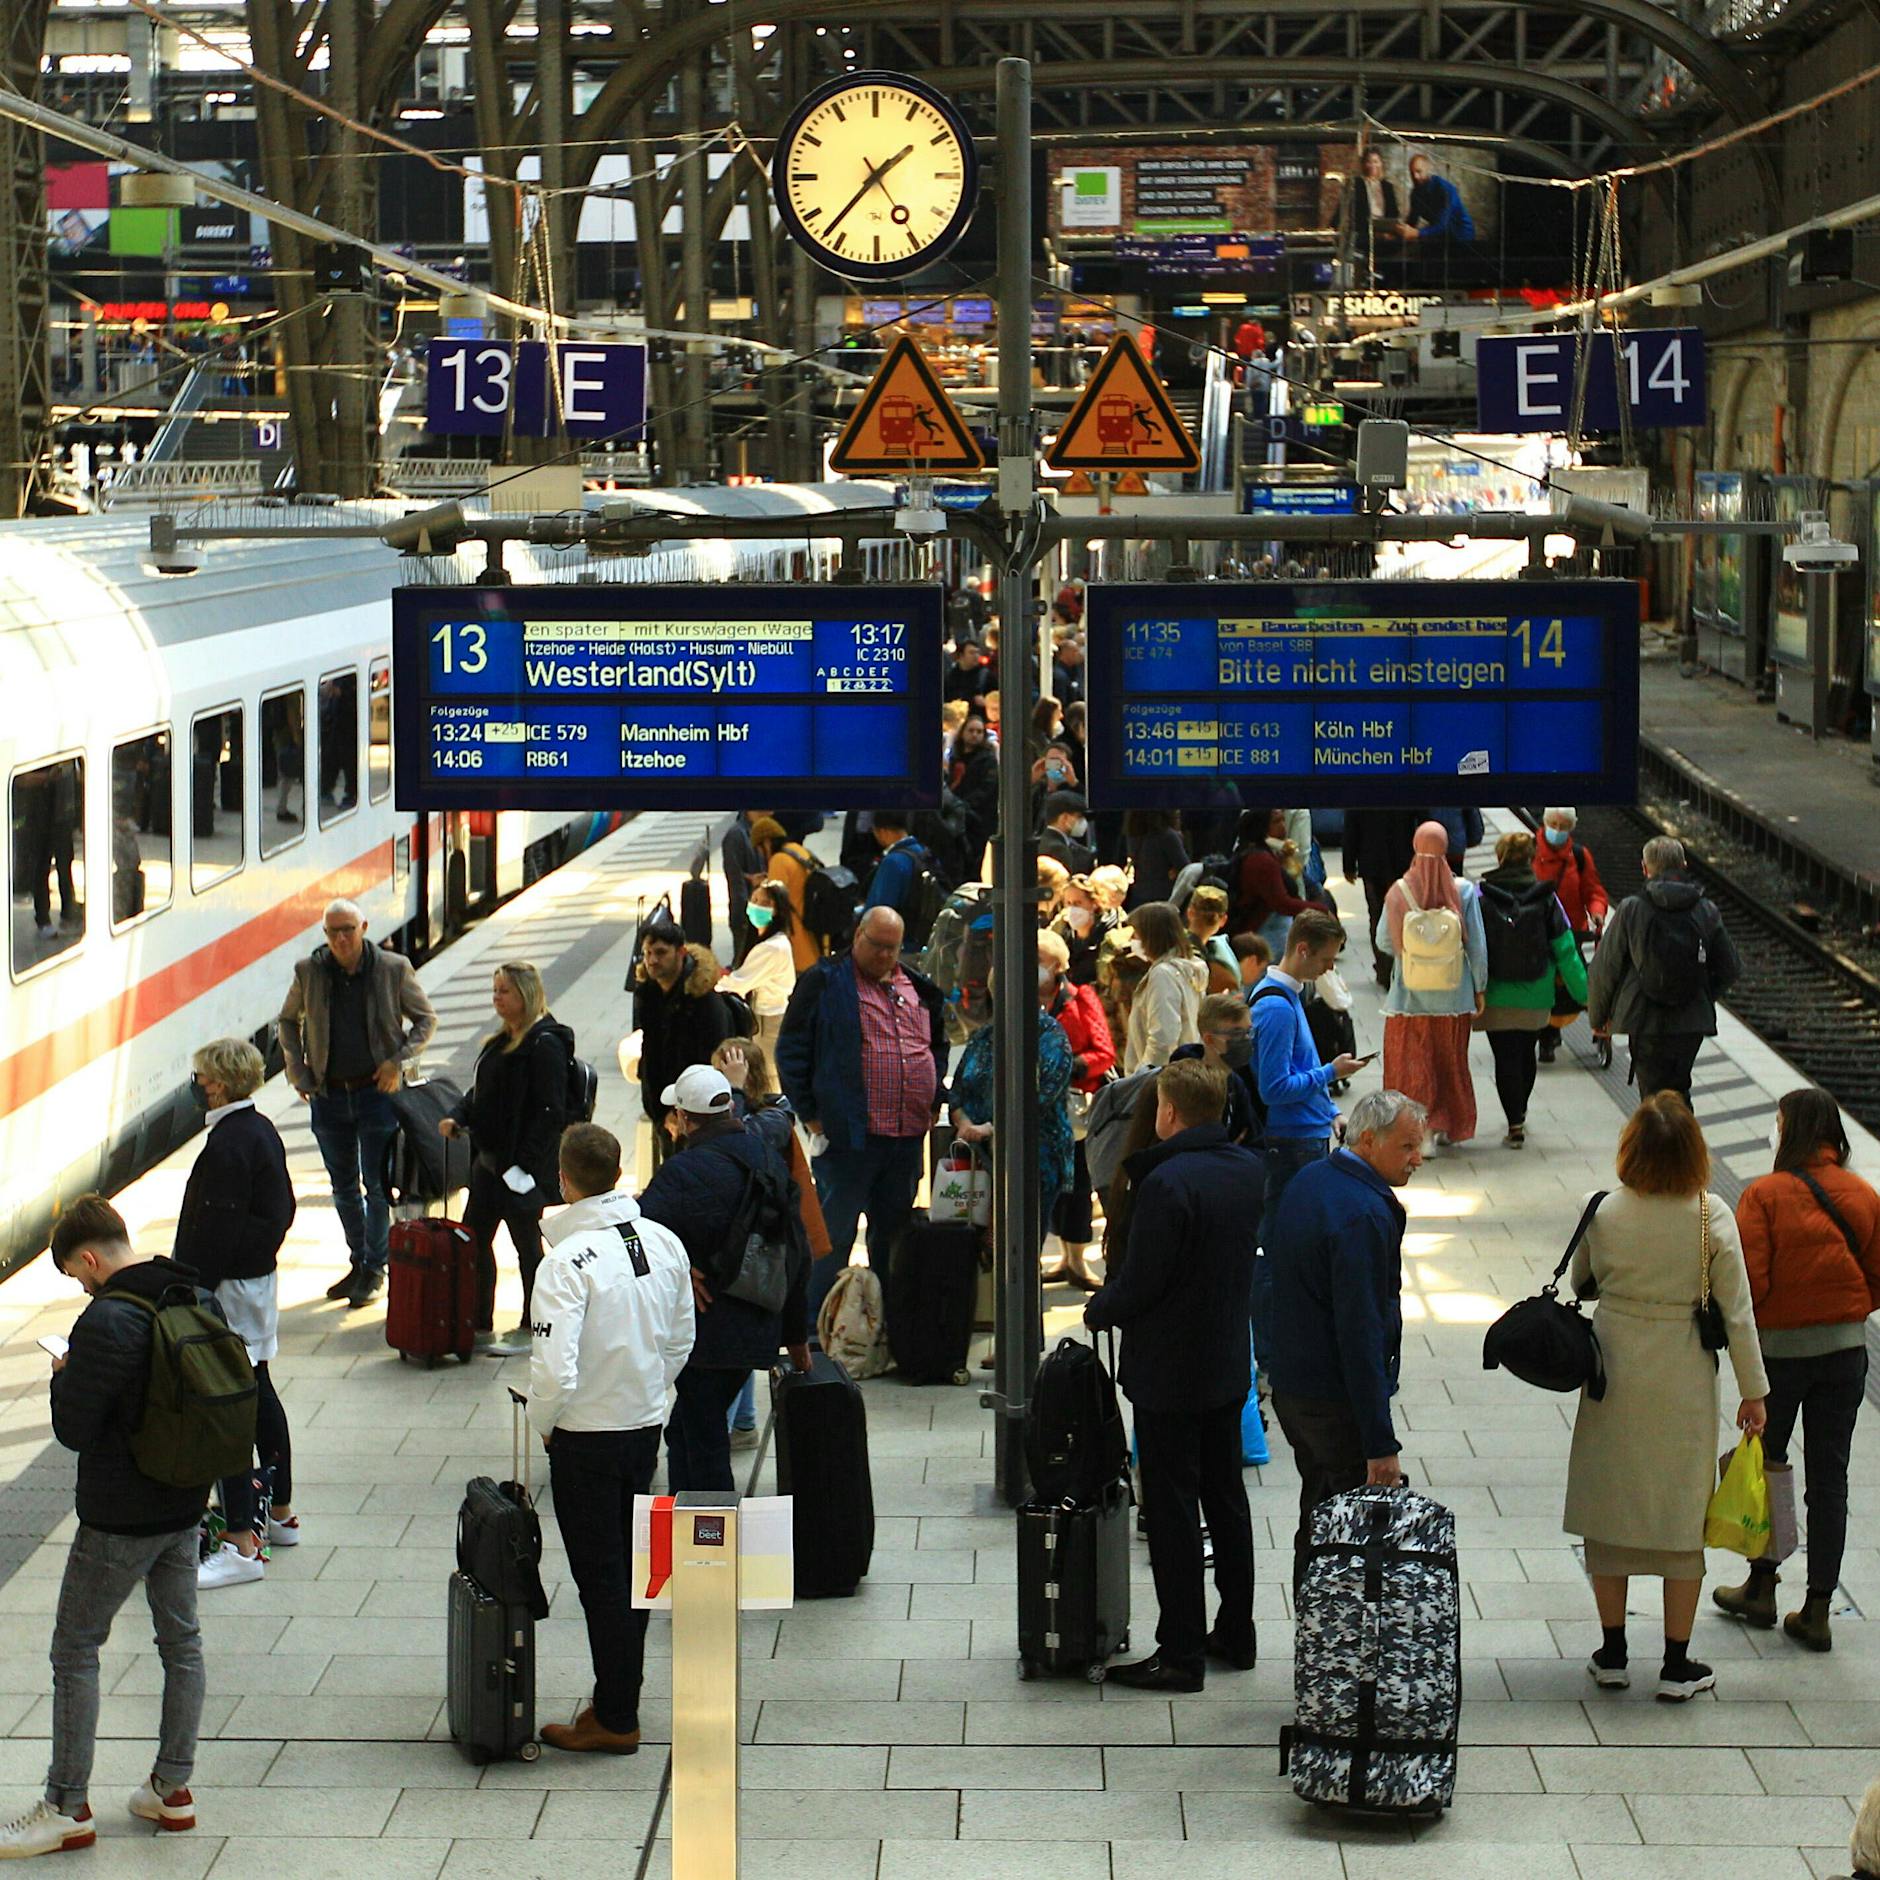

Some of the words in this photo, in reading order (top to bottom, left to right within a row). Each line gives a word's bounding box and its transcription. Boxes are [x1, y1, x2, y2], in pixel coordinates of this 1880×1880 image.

[195, 224, 236, 239] DIREKT
[441, 348, 512, 414] 13
[563, 352, 607, 421] E
[1516, 344, 1562, 416] E
[1623, 338, 1691, 405] 14
[259, 423, 276, 447] D
[1270, 418, 1286, 439] D
[634, 623, 659, 636] mit
[665, 623, 757, 639] Kurswagen
[850, 623, 905, 645] 13:17
[1126, 622, 1182, 643] 11:35
[1387, 620, 1418, 636] Zug
[1422, 620, 1471, 632] endet
[431, 623, 488, 674] 13
[525, 642, 576, 656] Itzehoe
[588, 642, 626, 656] Heide
[629, 642, 677, 656] (Holst)
[689, 641, 735, 655] Husum
[748, 641, 794, 655] Niebüll
[1124, 647, 1145, 660] ICE
[1149, 646, 1173, 660] 474
[1218, 641, 1245, 652] von
[1248, 639, 1284, 652] Basel
[1288, 639, 1313, 652] SBB
[1511, 619, 1566, 669] 14
[857, 648, 869, 661] IC
[872, 648, 905, 661] 2310
[525, 660, 756, 693] Westerland(Sylt)
[816, 666, 826, 677] A
[830, 666, 838, 677] B
[843, 666, 851, 677] C
[856, 666, 865, 677] D
[869, 666, 876, 677] E
[882, 666, 889, 677] F
[1219, 658, 1281, 684] Bitte
[1292, 658, 1358, 684] nicht
[1369, 657, 1505, 690] einsteigen
[430, 705, 489, 718] Folgezüge
[1123, 704, 1182, 717] Folgezüge
[432, 723, 482, 742] 13:24
[526, 724, 551, 741] ICE
[557, 724, 588, 741] 579
[621, 723, 710, 741] Mannheim
[717, 723, 749, 741] Hbf
[1124, 721, 1175, 740] 13:46
[1219, 722, 1244, 738] ICE
[1250, 722, 1280, 738] 613
[1314, 720, 1355, 739] Köln
[1362, 720, 1393, 738] Hbf
[432, 750, 483, 769] 14:06
[526, 751, 568, 768] RB61
[621, 750, 686, 769] Itzehoe
[1124, 748, 1174, 766] 14:01
[1219, 749, 1244, 765] ICE
[1250, 749, 1280, 765] 881
[1314, 747, 1393, 766] München
[1401, 747, 1433, 765] Hbf
[571, 1246, 599, 1270] HH
[532, 1322, 552, 1338] HH
